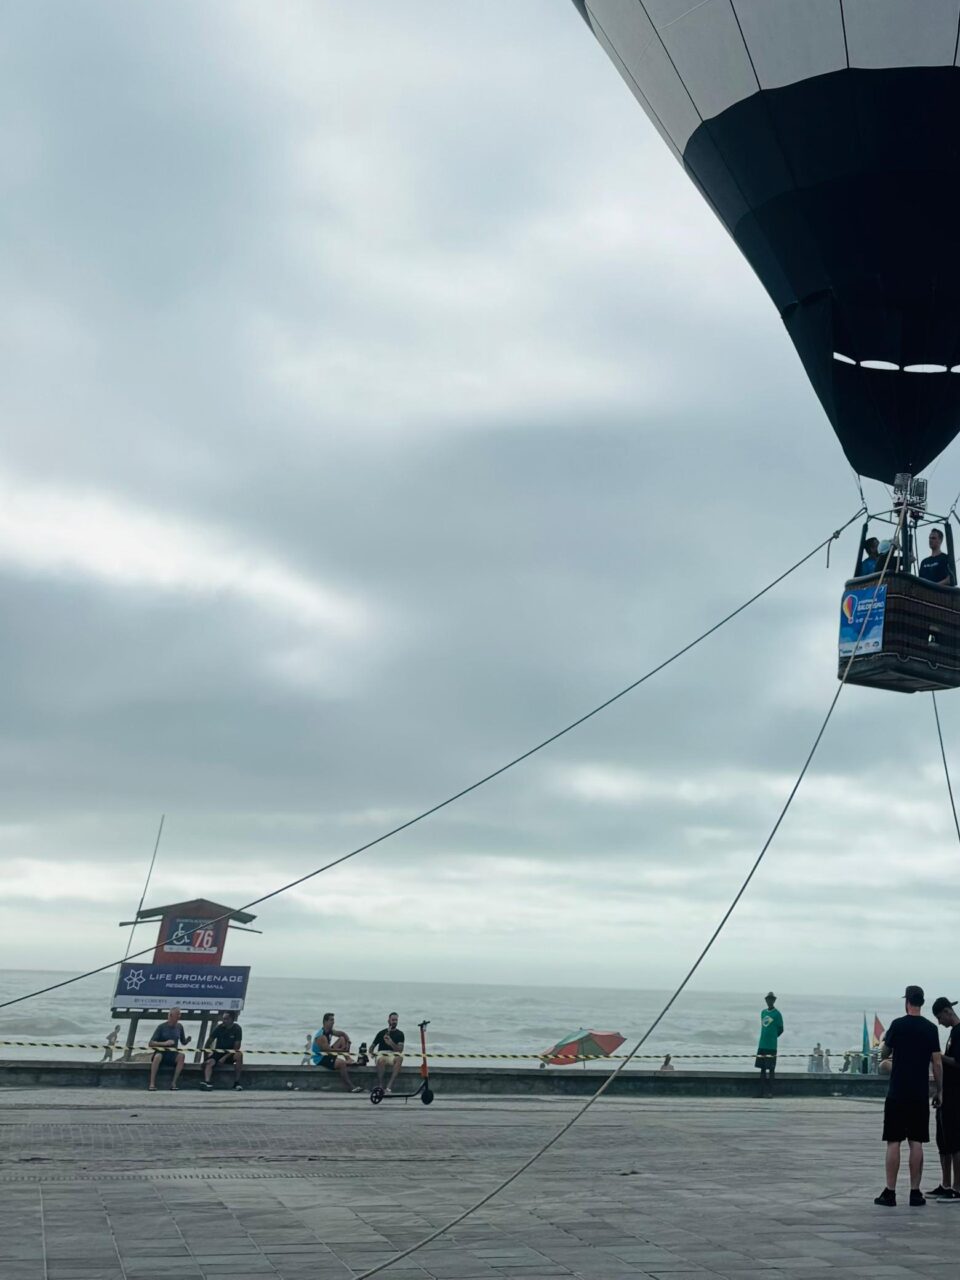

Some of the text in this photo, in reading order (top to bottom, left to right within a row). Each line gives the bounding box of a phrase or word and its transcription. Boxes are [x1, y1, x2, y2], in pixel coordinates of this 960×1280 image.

[194, 929, 214, 948] 76
[149, 973, 243, 983] LIFE PROMENADE
